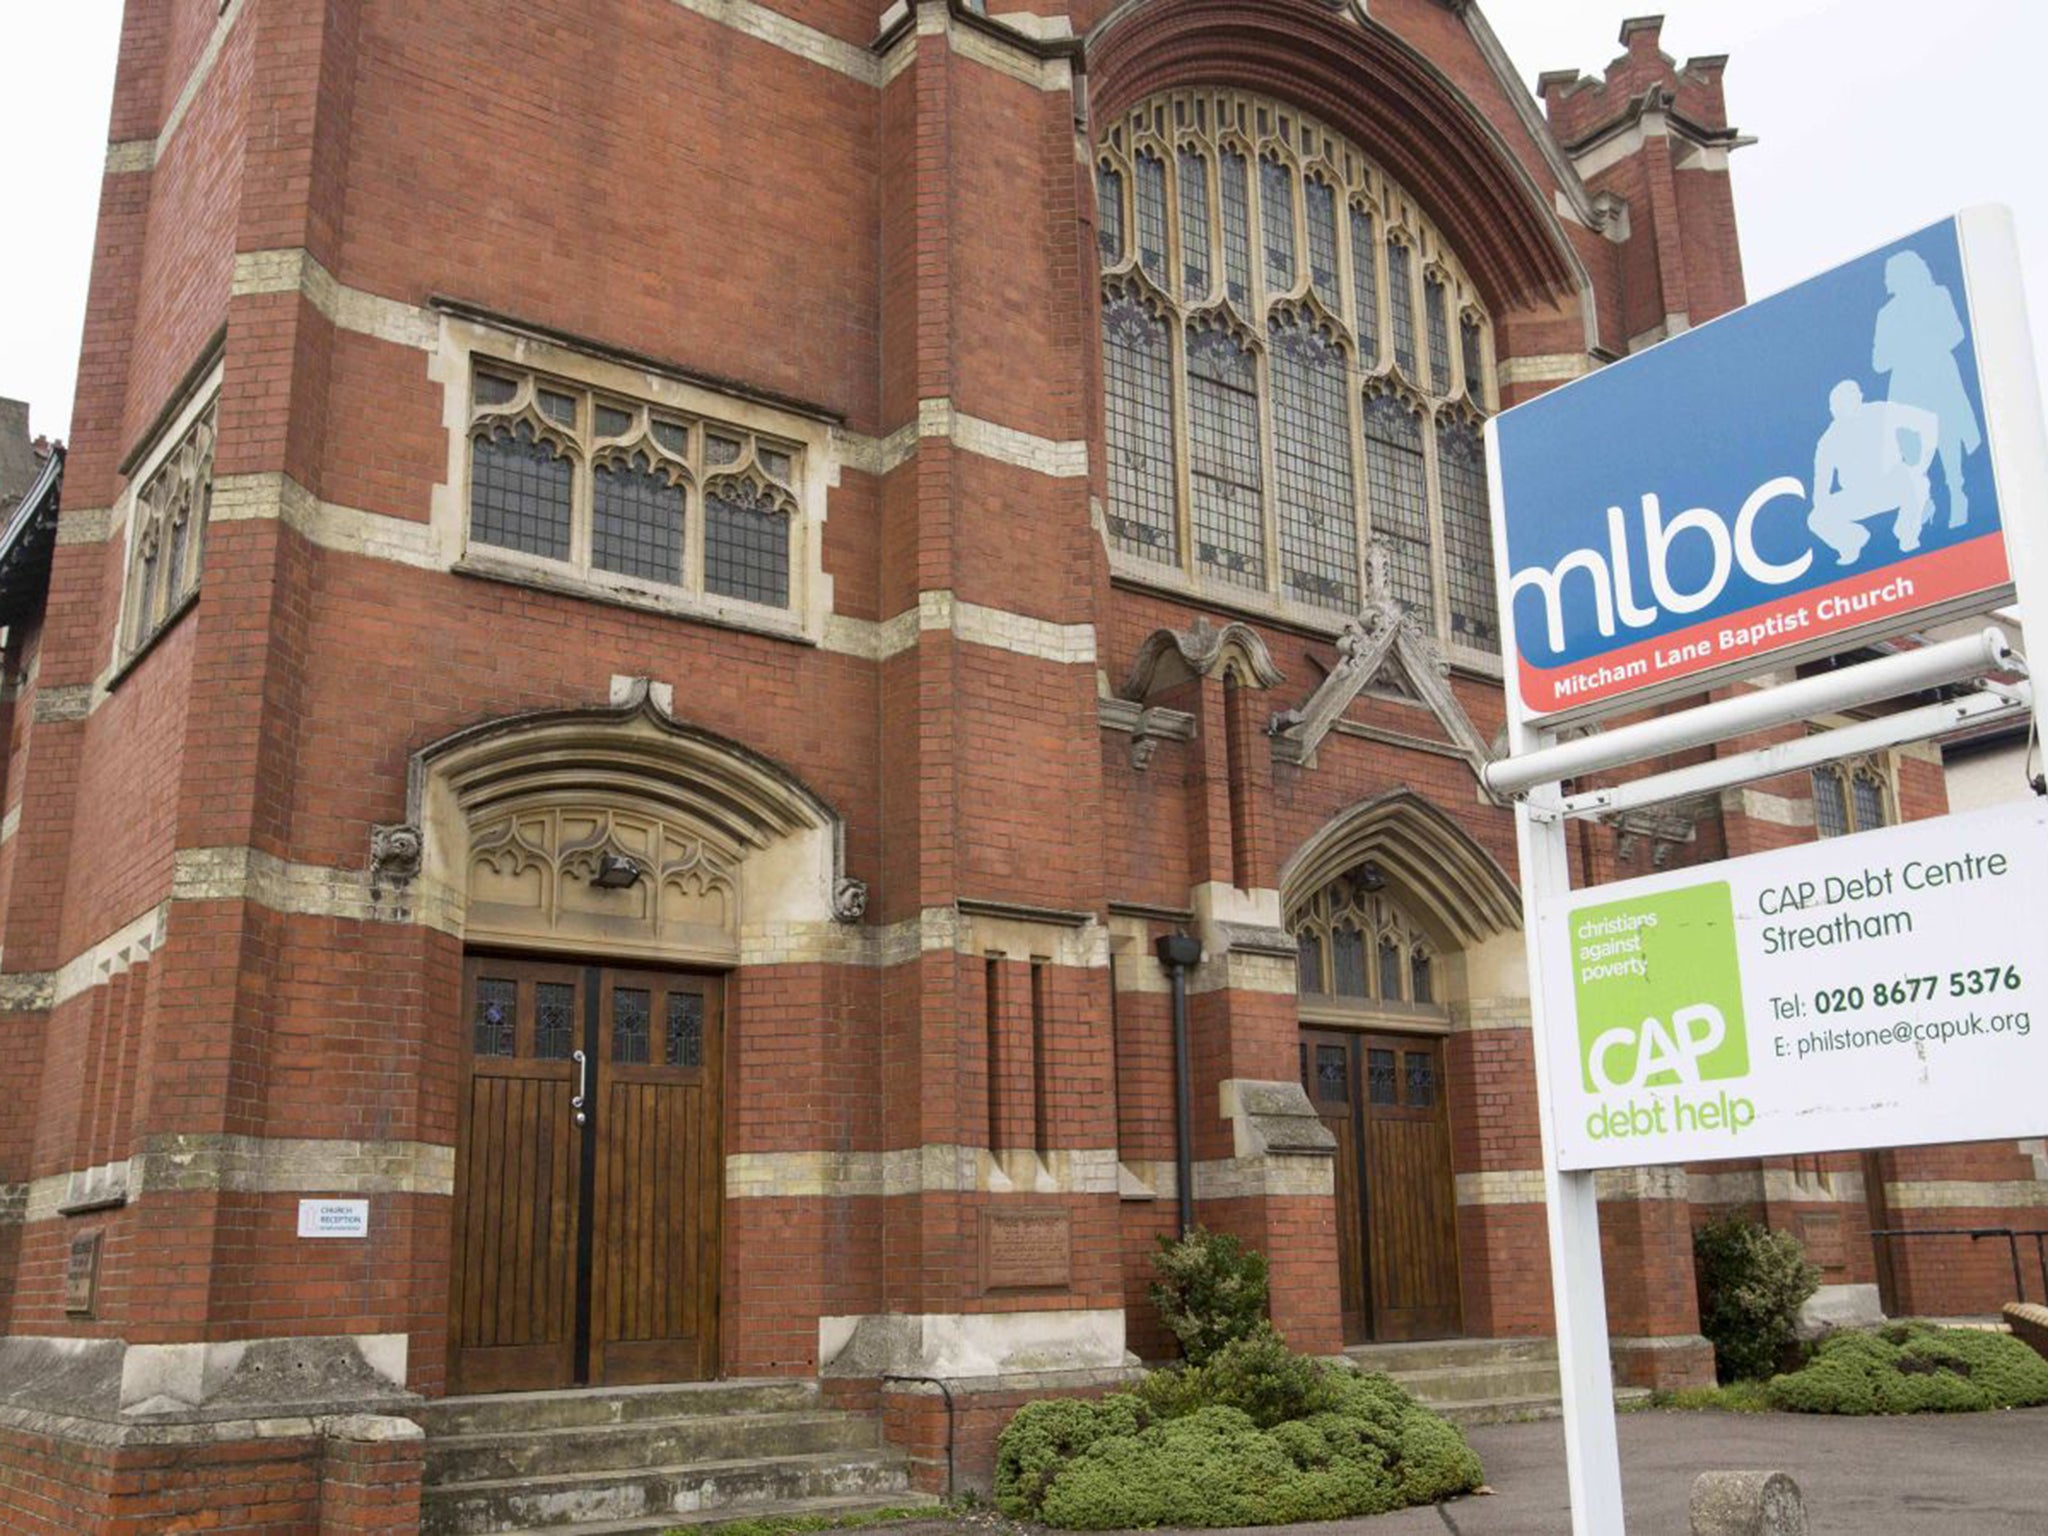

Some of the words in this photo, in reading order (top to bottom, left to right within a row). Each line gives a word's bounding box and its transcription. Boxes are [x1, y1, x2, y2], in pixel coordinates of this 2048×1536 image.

[1510, 476, 1813, 654] mlbc
[1554, 655, 1648, 699] Mitcham
[1654, 640, 1711, 669] Lane
[1719, 607, 1809, 650] Baptist
[1816, 577, 1914, 621] Church
[1758, 882, 1816, 916] CAP
[1824, 868, 1893, 905] Debt
[1902, 852, 2008, 890] Centre
[1578, 912, 1658, 940] christians
[1579, 934, 1641, 961] against
[1762, 910, 1913, 954] Streatham
[1582, 956, 1648, 984] poverty
[1770, 994, 1807, 1020] Tel:
[1814, 986, 1864, 1015] 020
[1873, 976, 1938, 1007] 8677
[1949, 965, 2022, 997] 5376
[1588, 1003, 1726, 1095] CAP
[1774, 1036, 1791, 1057] E:
[1797, 1011, 2031, 1060] philstone@capuk.org
[1586, 1099, 1668, 1140] debt
[1673, 1090, 1755, 1136] help
